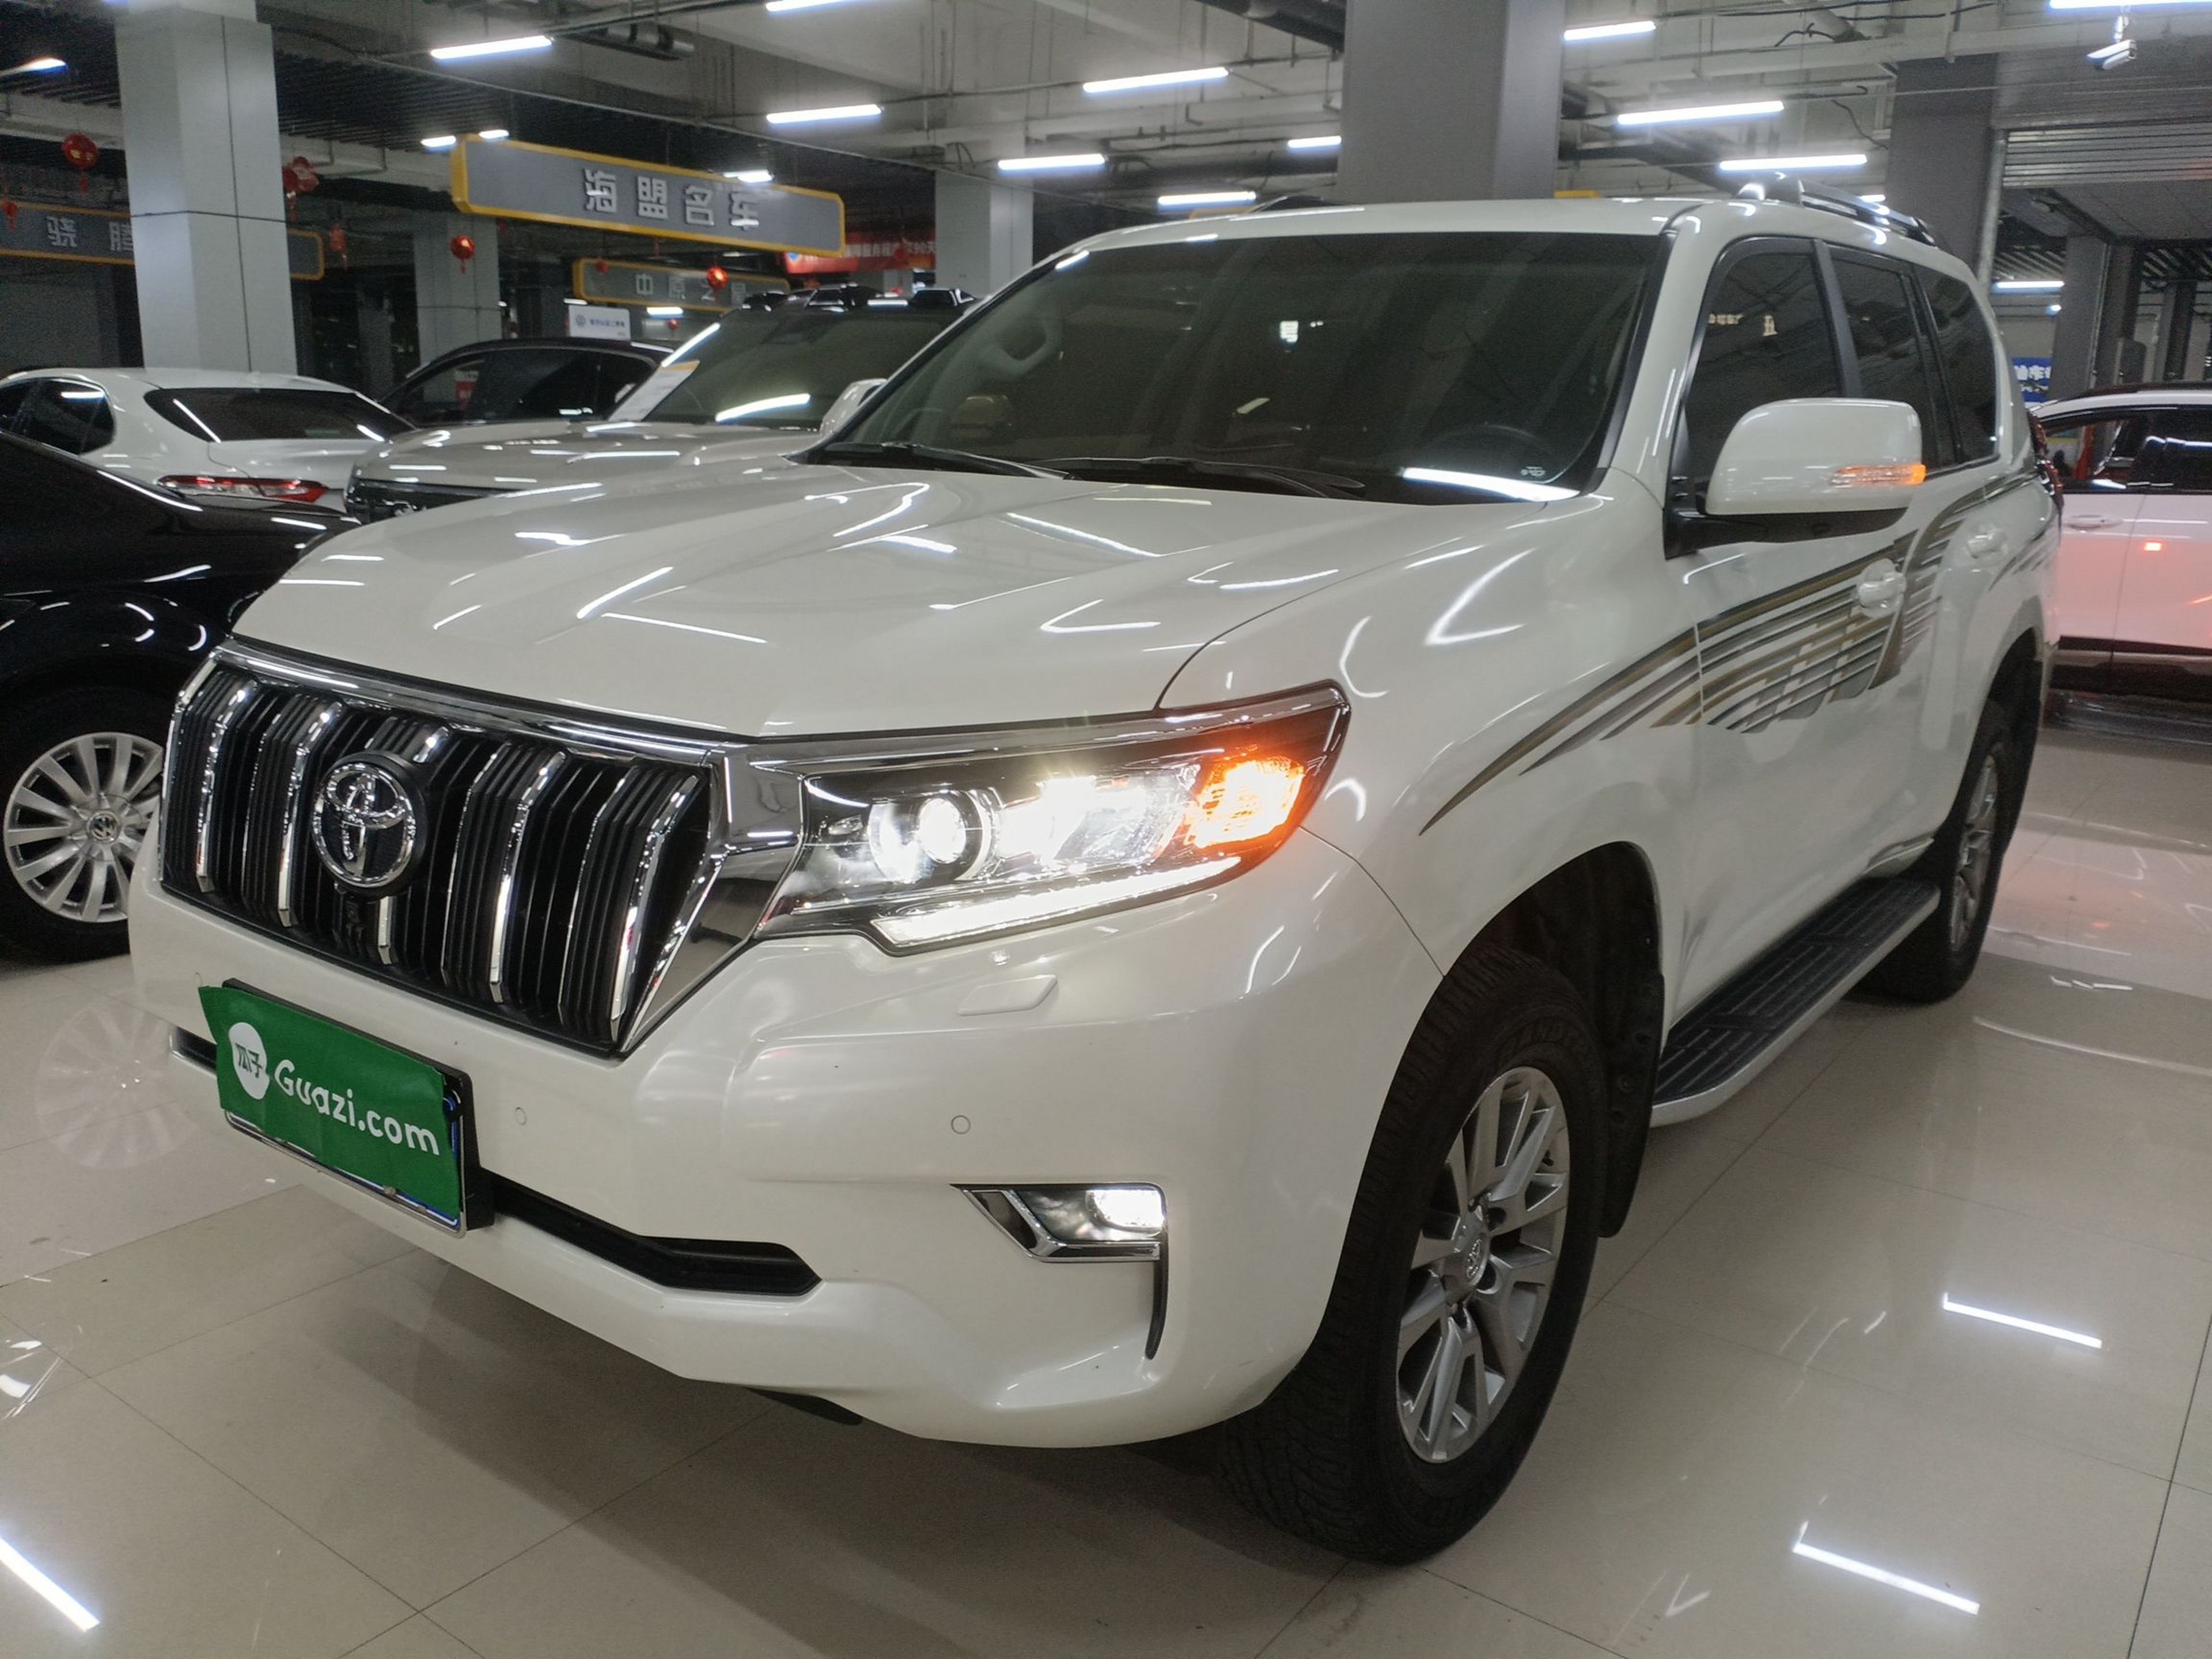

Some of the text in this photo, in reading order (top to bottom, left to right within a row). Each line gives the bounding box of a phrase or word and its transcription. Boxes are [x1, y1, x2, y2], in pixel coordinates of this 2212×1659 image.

[583, 168, 760, 231] 海盟名车
[235, 1043, 263, 1078] 瓜子
[274, 1059, 440, 1156] Guazi.com
